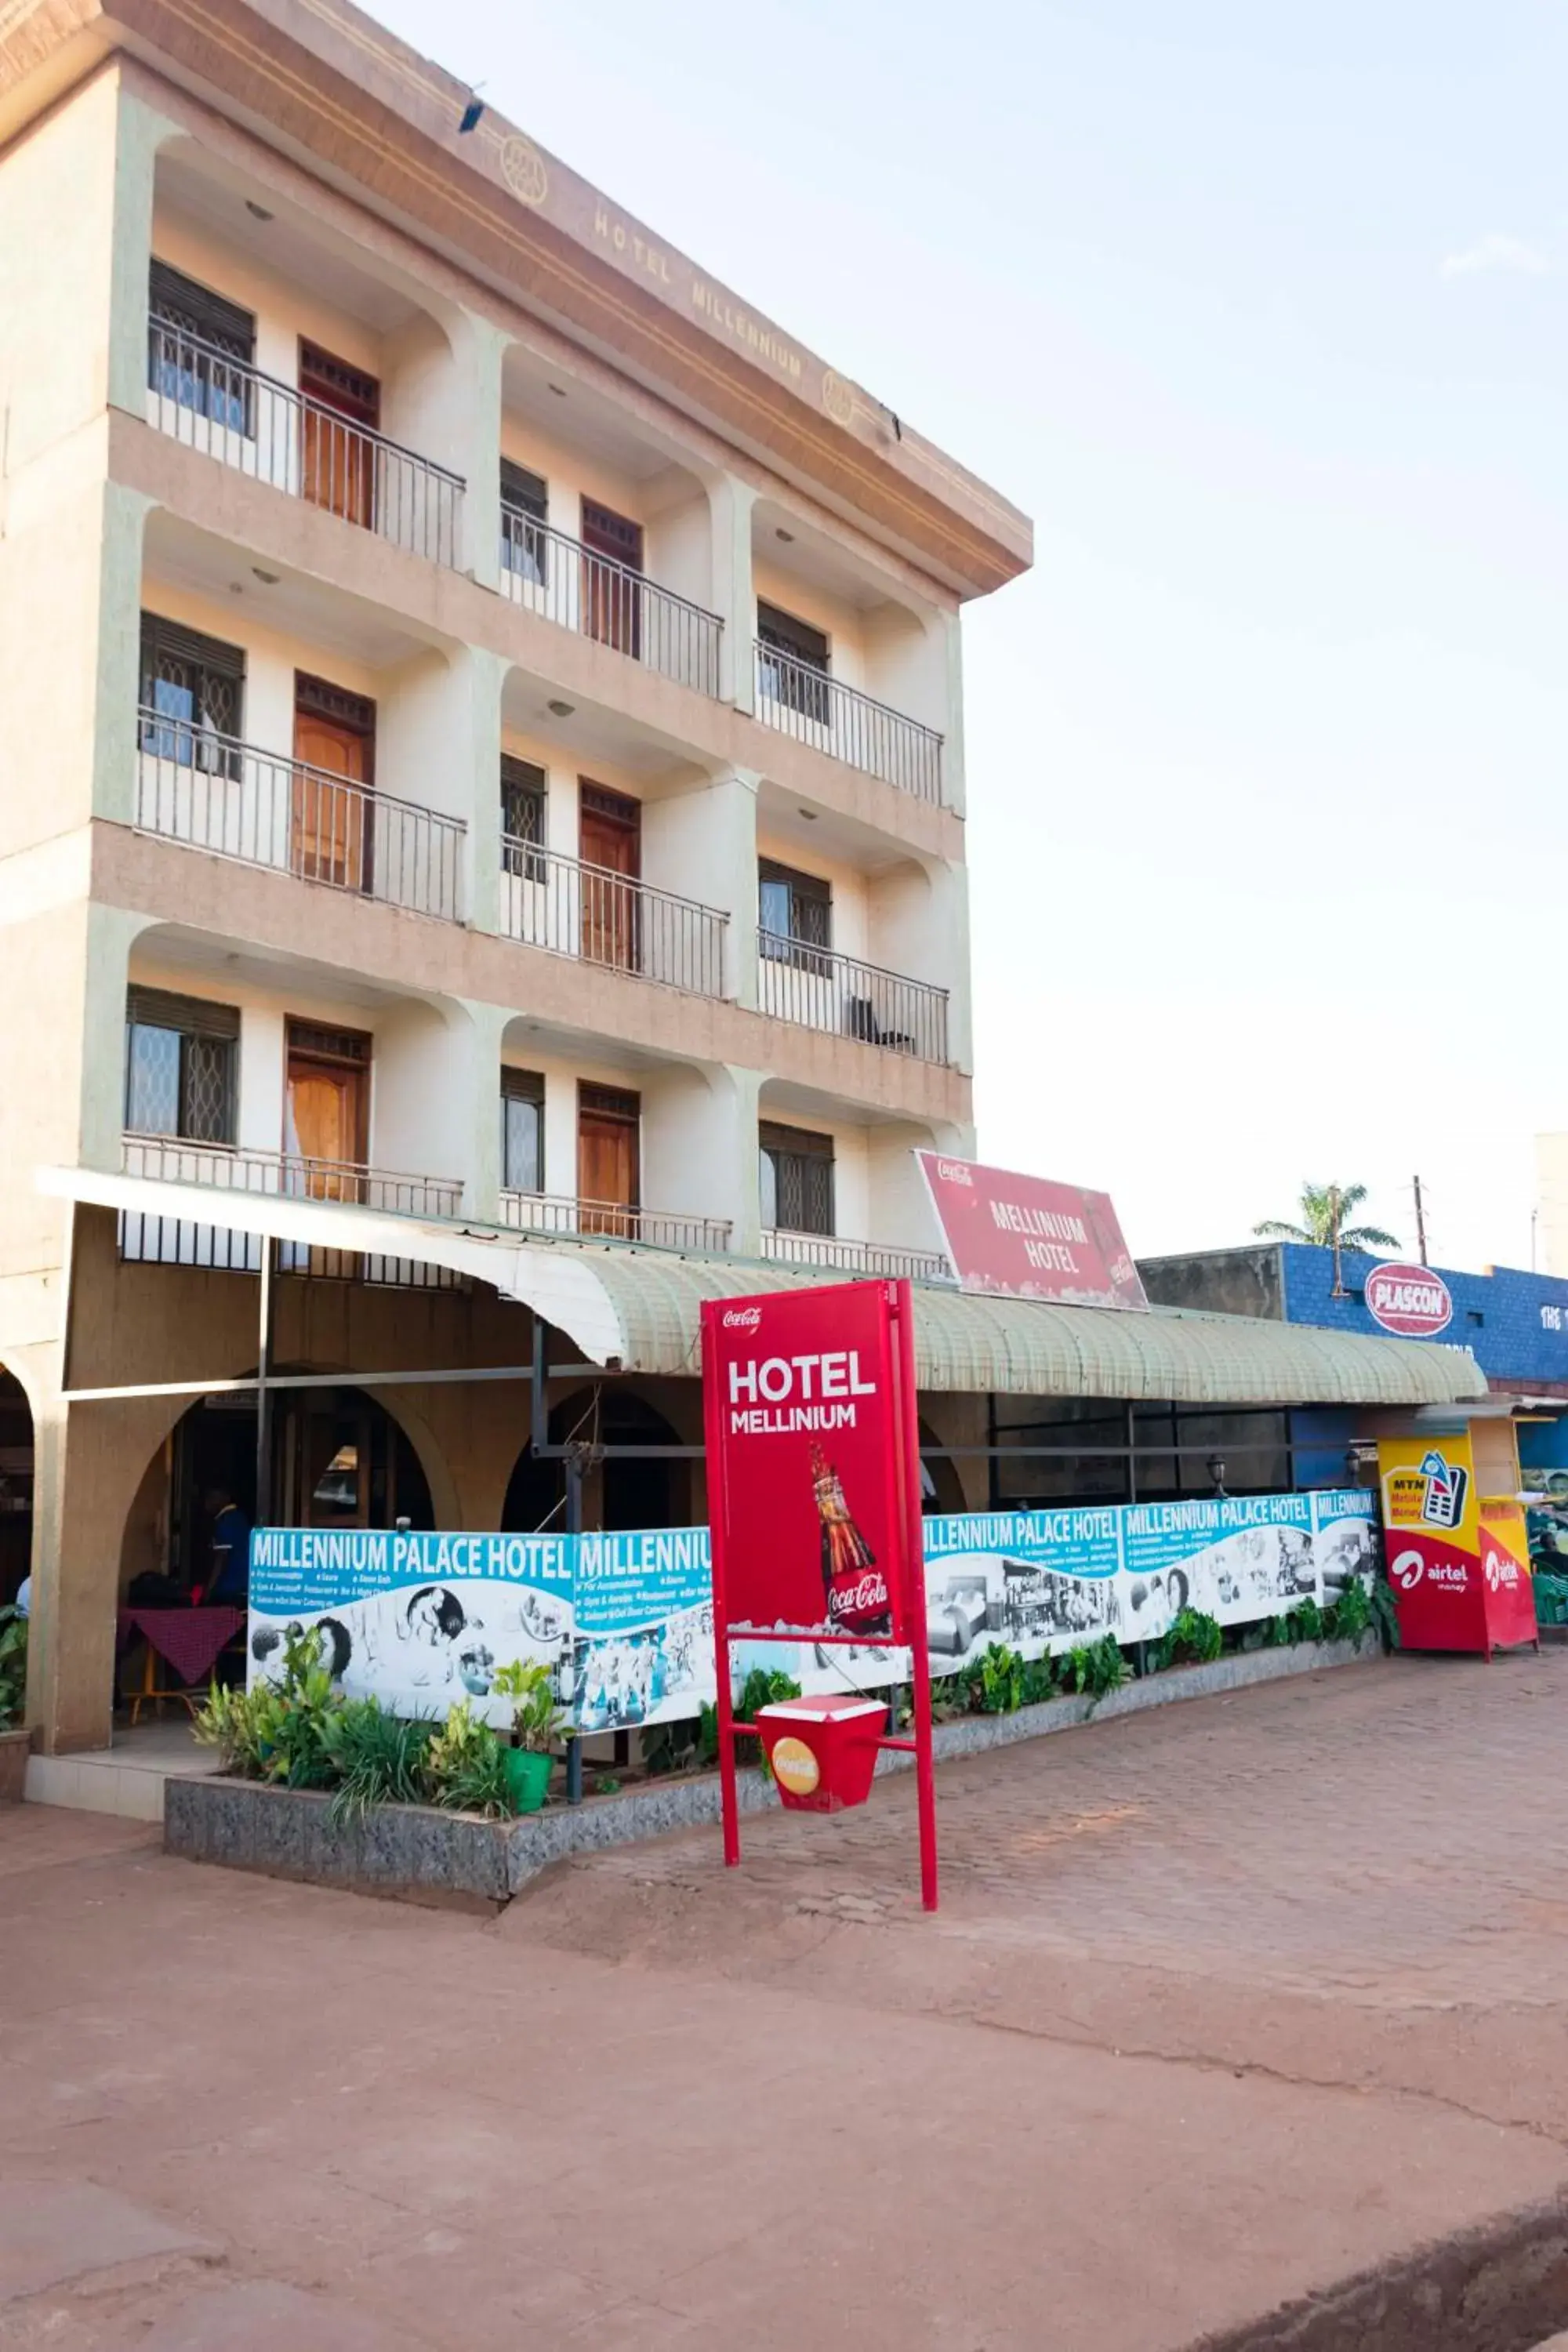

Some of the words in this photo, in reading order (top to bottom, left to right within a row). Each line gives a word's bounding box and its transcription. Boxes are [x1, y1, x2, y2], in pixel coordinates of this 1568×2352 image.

[594, 208, 670, 285] HOTEL
[691, 281, 800, 378] MILLENNIUM
[989, 1200, 1088, 1244] MELLINIUM
[1023, 1240, 1080, 1274] HOTEL
[723, 1307, 762, 1327] Coca-Cola
[1374, 1283, 1443, 1315] PLASCON
[1540, 1305, 1562, 1330] THE
[728, 1350, 877, 1404] HOTEL
[731, 1403, 857, 1434] MELLINIUM
[1393, 1479, 1425, 1490] MTN
[924, 1517, 1014, 1552] ILLENNIUM
[1015, 1514, 1071, 1547] PALACE
[1073, 1510, 1118, 1541] HOTEL
[1126, 1503, 1219, 1534] MILLENNIUM
[1221, 1498, 1269, 1528] PALACE
[1270, 1495, 1309, 1522] HOTEL
[253, 1533, 388, 1571] MILLENNIUM
[393, 1536, 482, 1576] PALACE
[488, 1537, 572, 1579] HOTEL
[579, 1532, 712, 1578] MILLENNIU
[1428, 1563, 1468, 1581] airtel
[827, 1571, 888, 1619] Coca-Cola
